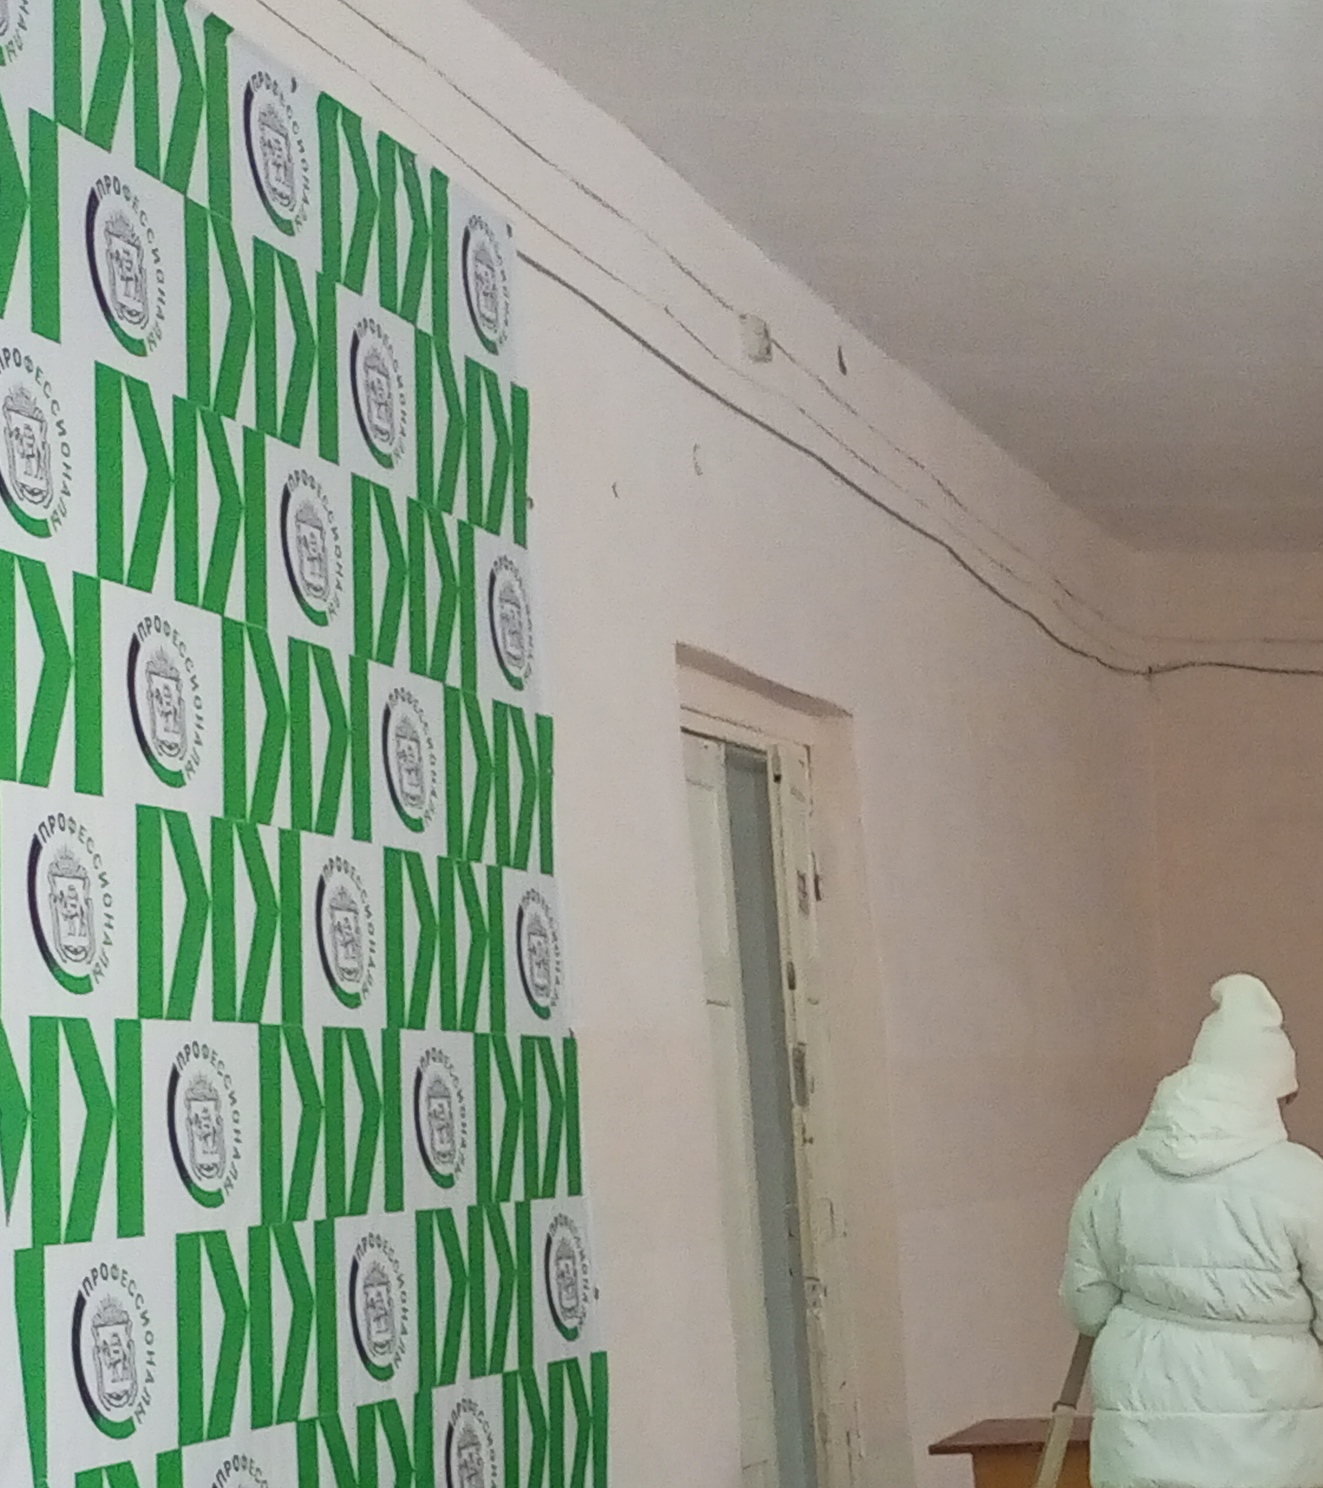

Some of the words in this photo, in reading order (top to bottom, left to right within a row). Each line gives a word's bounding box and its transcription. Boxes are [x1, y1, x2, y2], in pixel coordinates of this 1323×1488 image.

[95, 174, 166, 352] ПРОФЕССИОНАЛЫ
[137, 614, 202, 780] ПРОФЕССИОНАЛЫ
[38, 812, 115, 985] ПРОФЕССИОНАЛЫ
[176, 1040, 244, 1197] ПРОФЕССИОНАЛЫ
[83, 1262, 157, 1425] ПРОФЕССИОНАЛЫ
